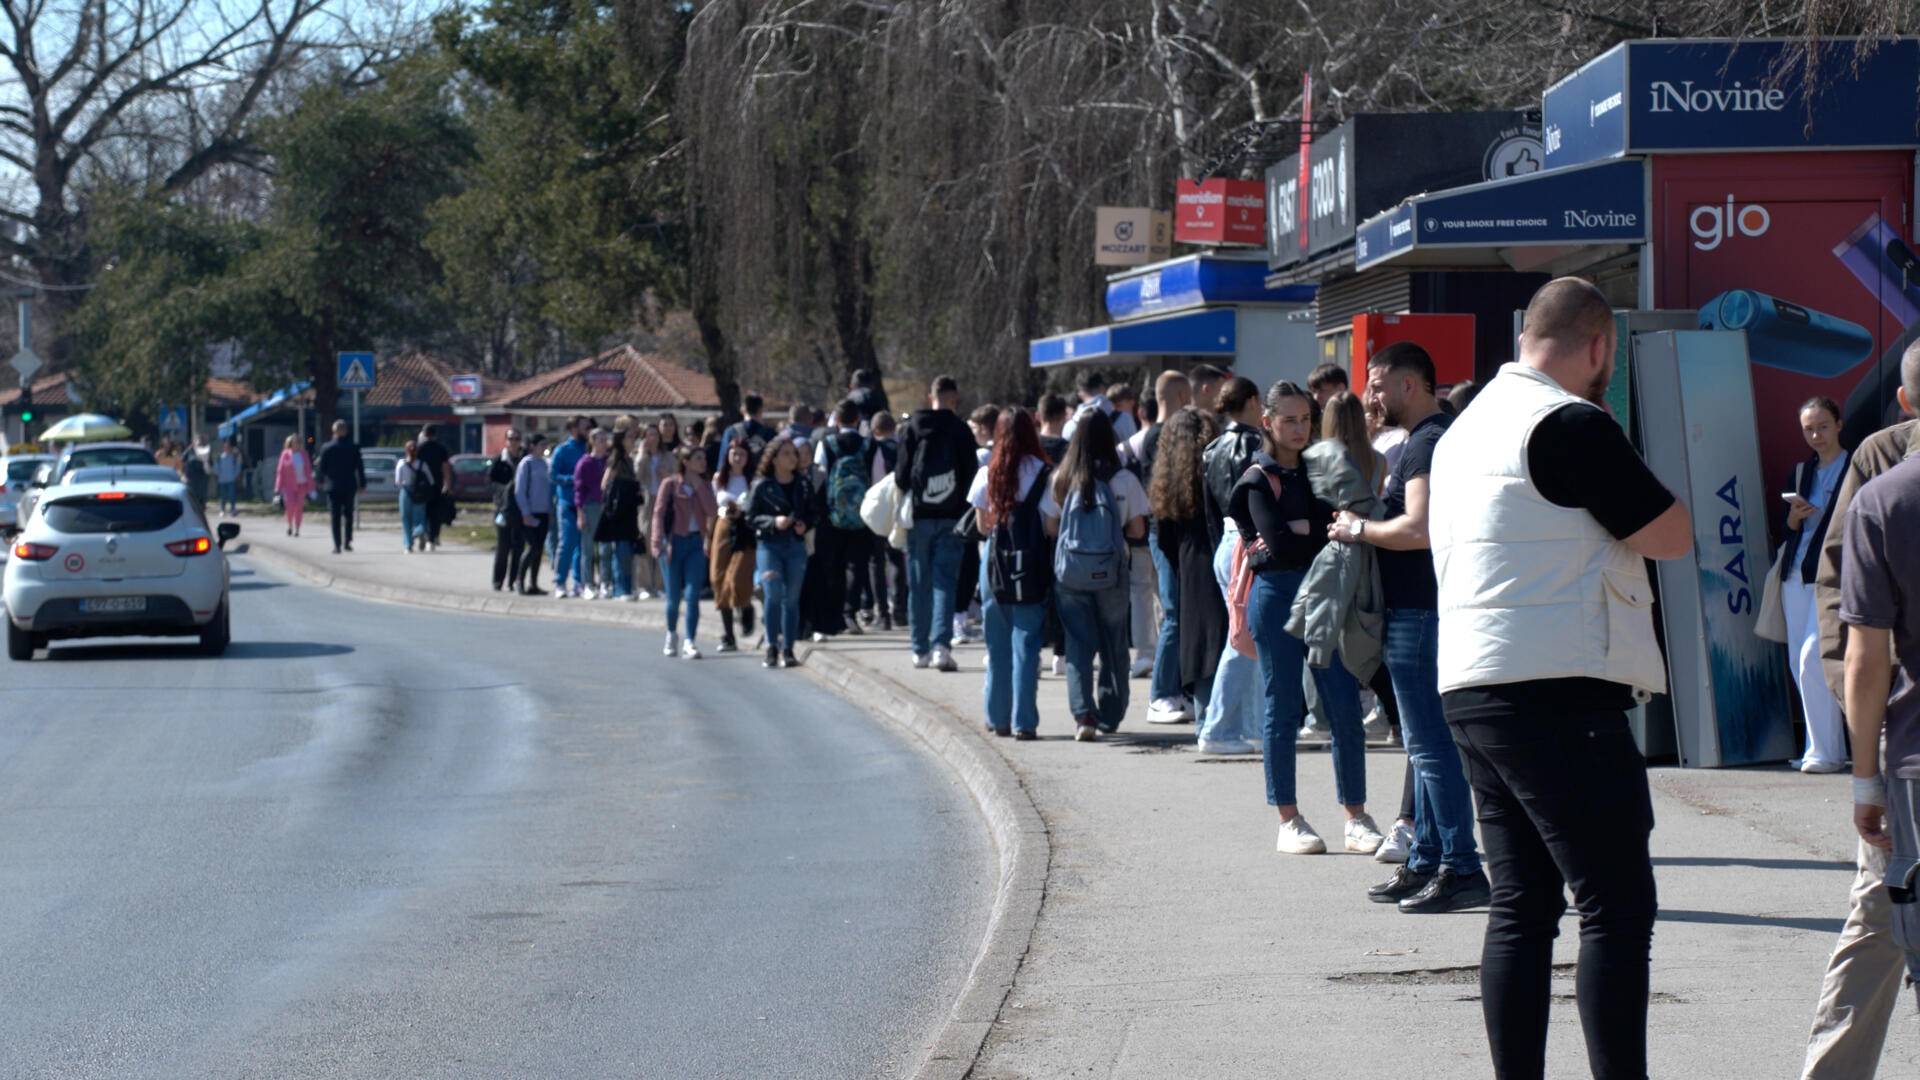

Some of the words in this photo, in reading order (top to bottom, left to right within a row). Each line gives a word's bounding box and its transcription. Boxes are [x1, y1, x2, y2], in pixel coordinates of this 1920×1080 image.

[1650, 81, 1784, 112] iNovine
[1179, 191, 1223, 204] meridian
[1313, 157, 1335, 220] FOOD
[1442, 220, 1465, 228] YOUR
[1466, 219, 1494, 228] SMOKE
[1496, 219, 1515, 227] FREE
[1516, 218, 1548, 227] CHOICE
[1564, 209, 1637, 228] iNovine
[1690, 194, 1770, 250] glo
[1102, 244, 1147, 252] MOZZART
[1715, 475, 1752, 616] SARA
